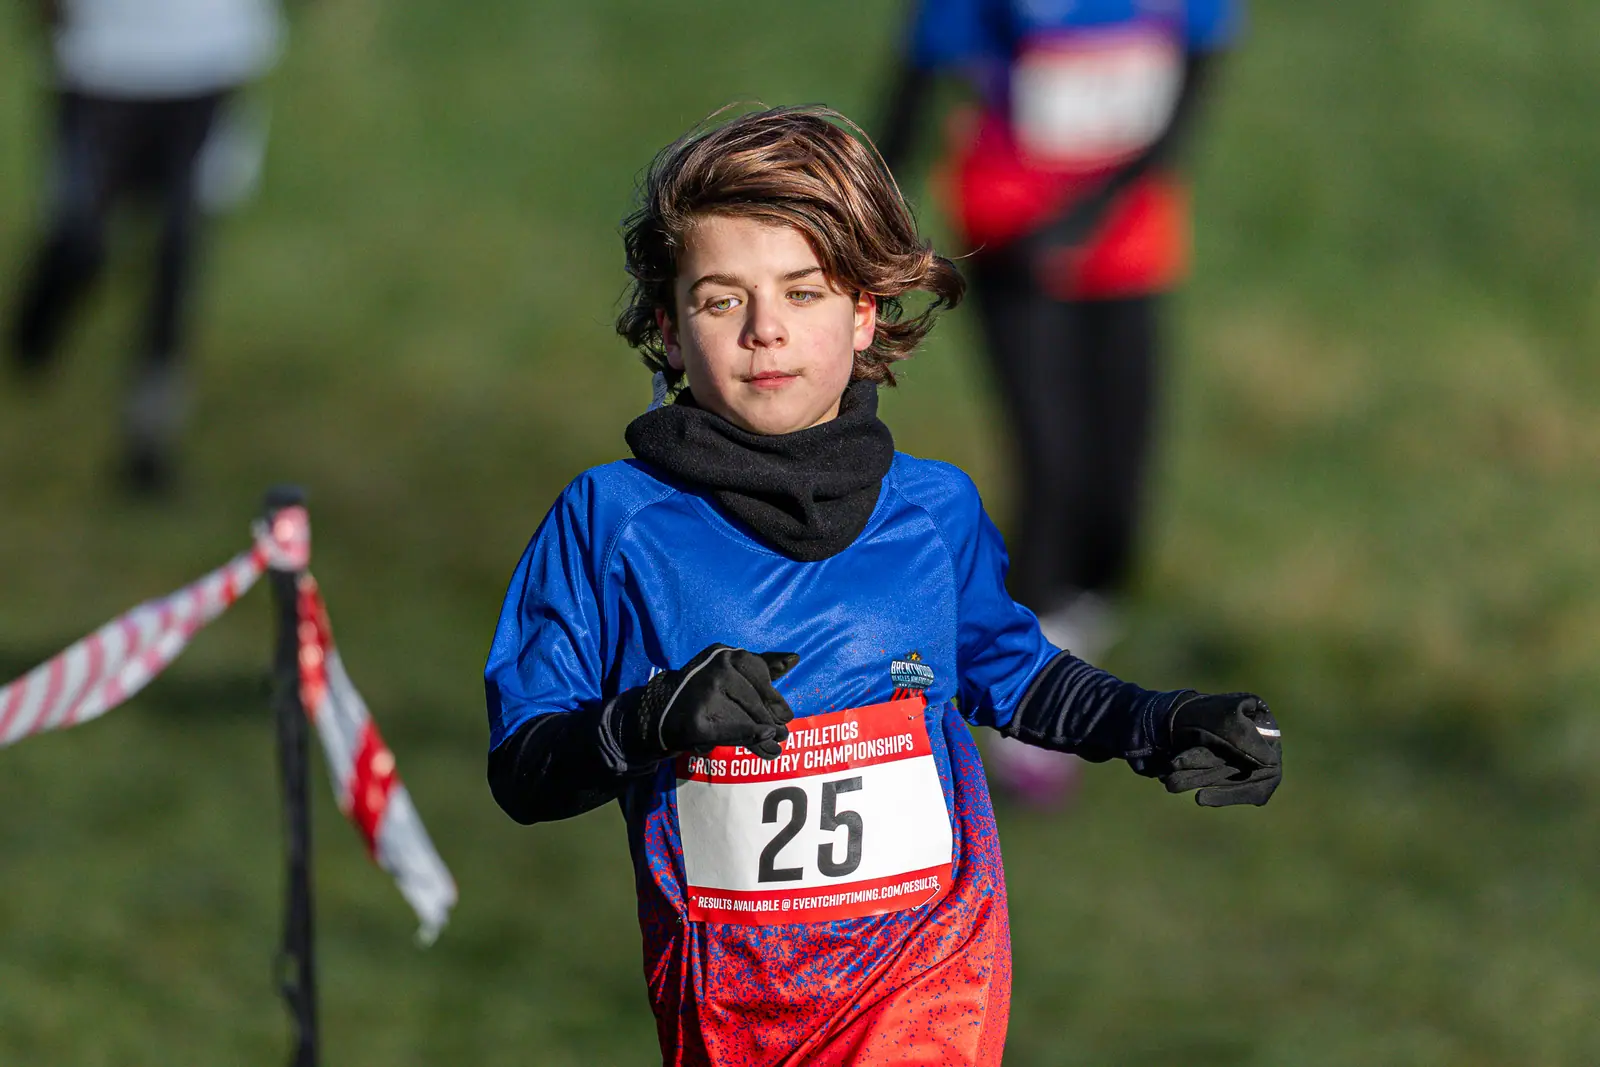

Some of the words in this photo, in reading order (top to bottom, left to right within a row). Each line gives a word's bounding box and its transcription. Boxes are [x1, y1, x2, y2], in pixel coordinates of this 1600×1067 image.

[688, 755, 727, 777] CROSS
[730, 753, 801, 776] COUNTRY
[803, 733, 914, 769] CHAMPIONSHIPS
[785, 721, 859, 750] ATHLETICS
[757, 776, 864, 884] 25
[698, 896, 732, 911] RESULTS
[733, 898, 780, 912] AVAILABLE
[792, 875, 939, 911] EVENTCHIPTIMING.COM/RESULTS
